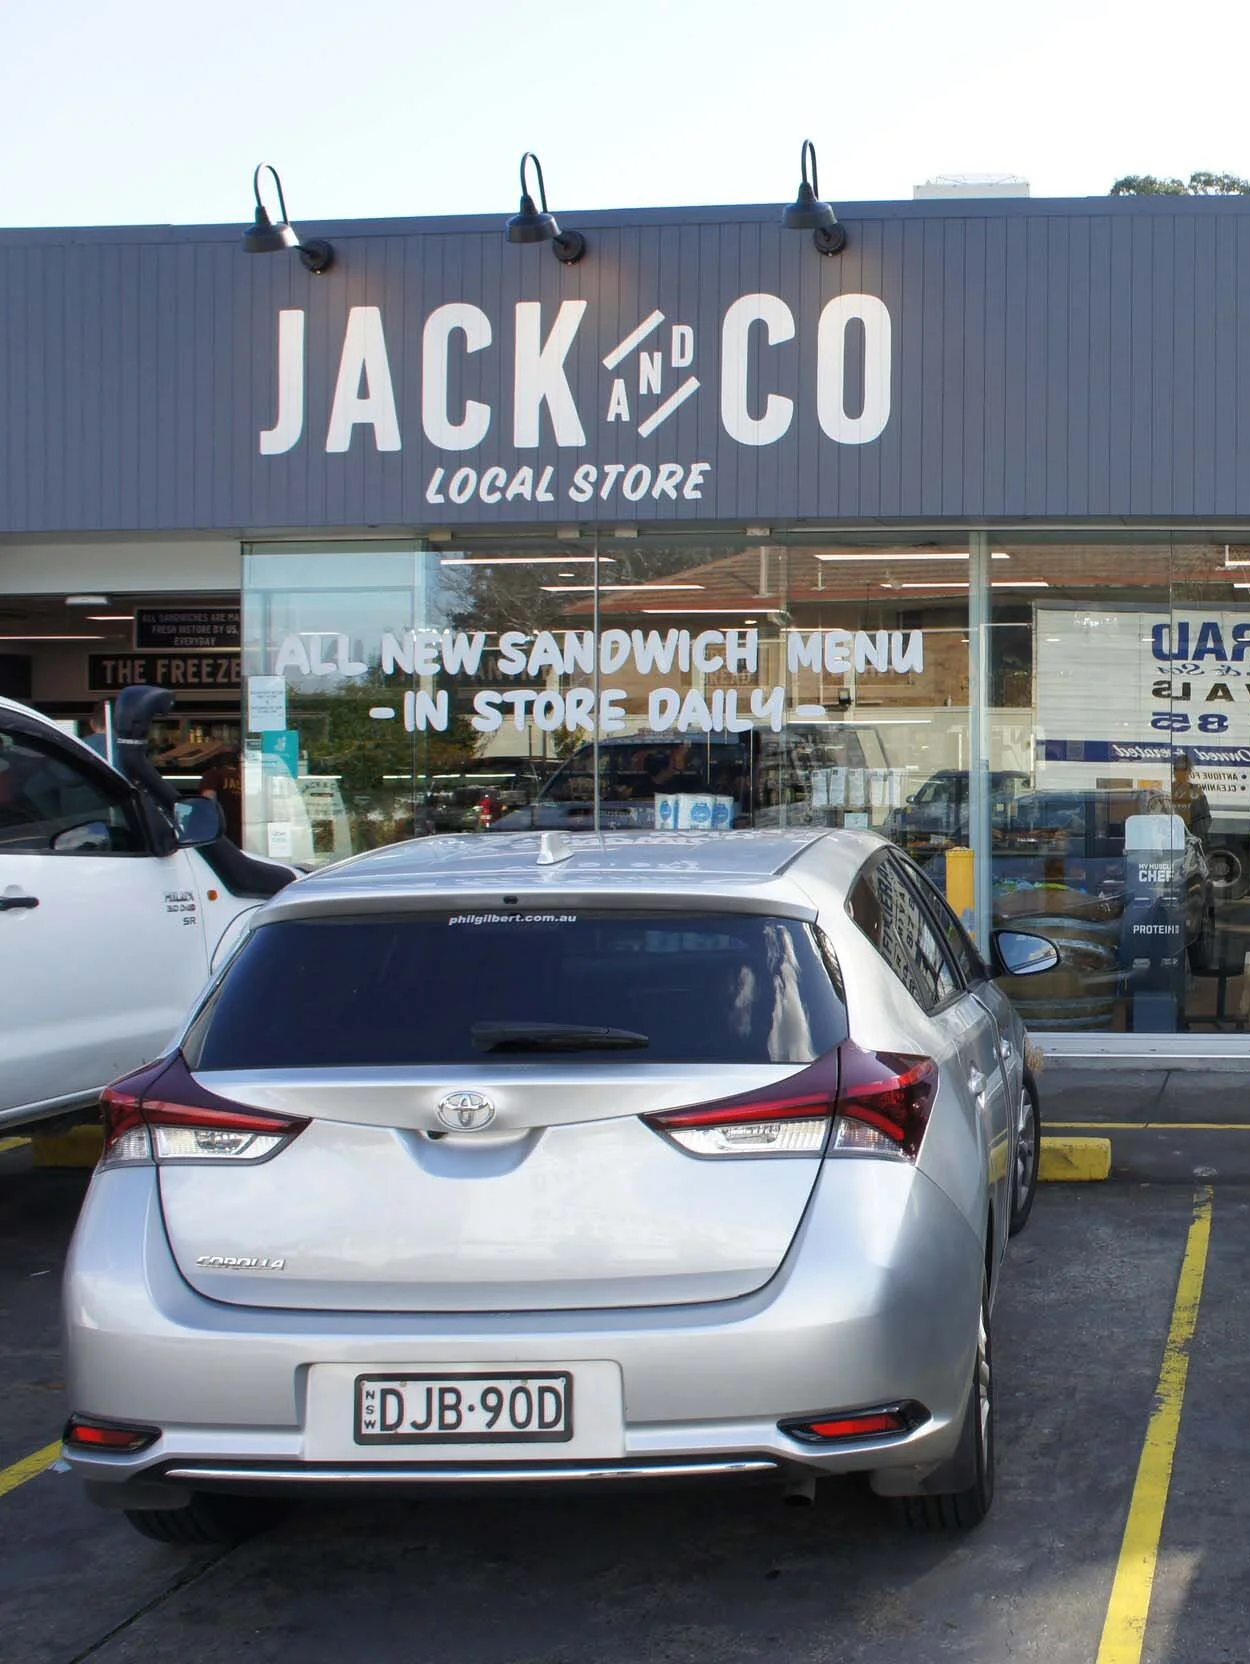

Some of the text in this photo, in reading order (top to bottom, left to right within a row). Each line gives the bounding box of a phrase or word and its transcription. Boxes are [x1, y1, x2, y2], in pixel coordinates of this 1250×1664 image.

[259, 293, 892, 455] JACK AND CO
[426, 463, 711, 504] LOCAL STORE
[173, 637, 216, 646] EVERYDAY
[275, 631, 367, 675] ALL
[381, 630, 486, 675] NEW
[499, 628, 758, 675] SANDWICH
[787, 629, 924, 674] MENU
[102, 659, 146, 684] THE
[472, 685, 627, 732] STORE
[1139, 870, 1175, 882] CHEF
[183, 916, 196, 926] SR
[448, 913, 577, 925] philgilbert.com.au
[196, 1255, 286, 1271] COROLLA
